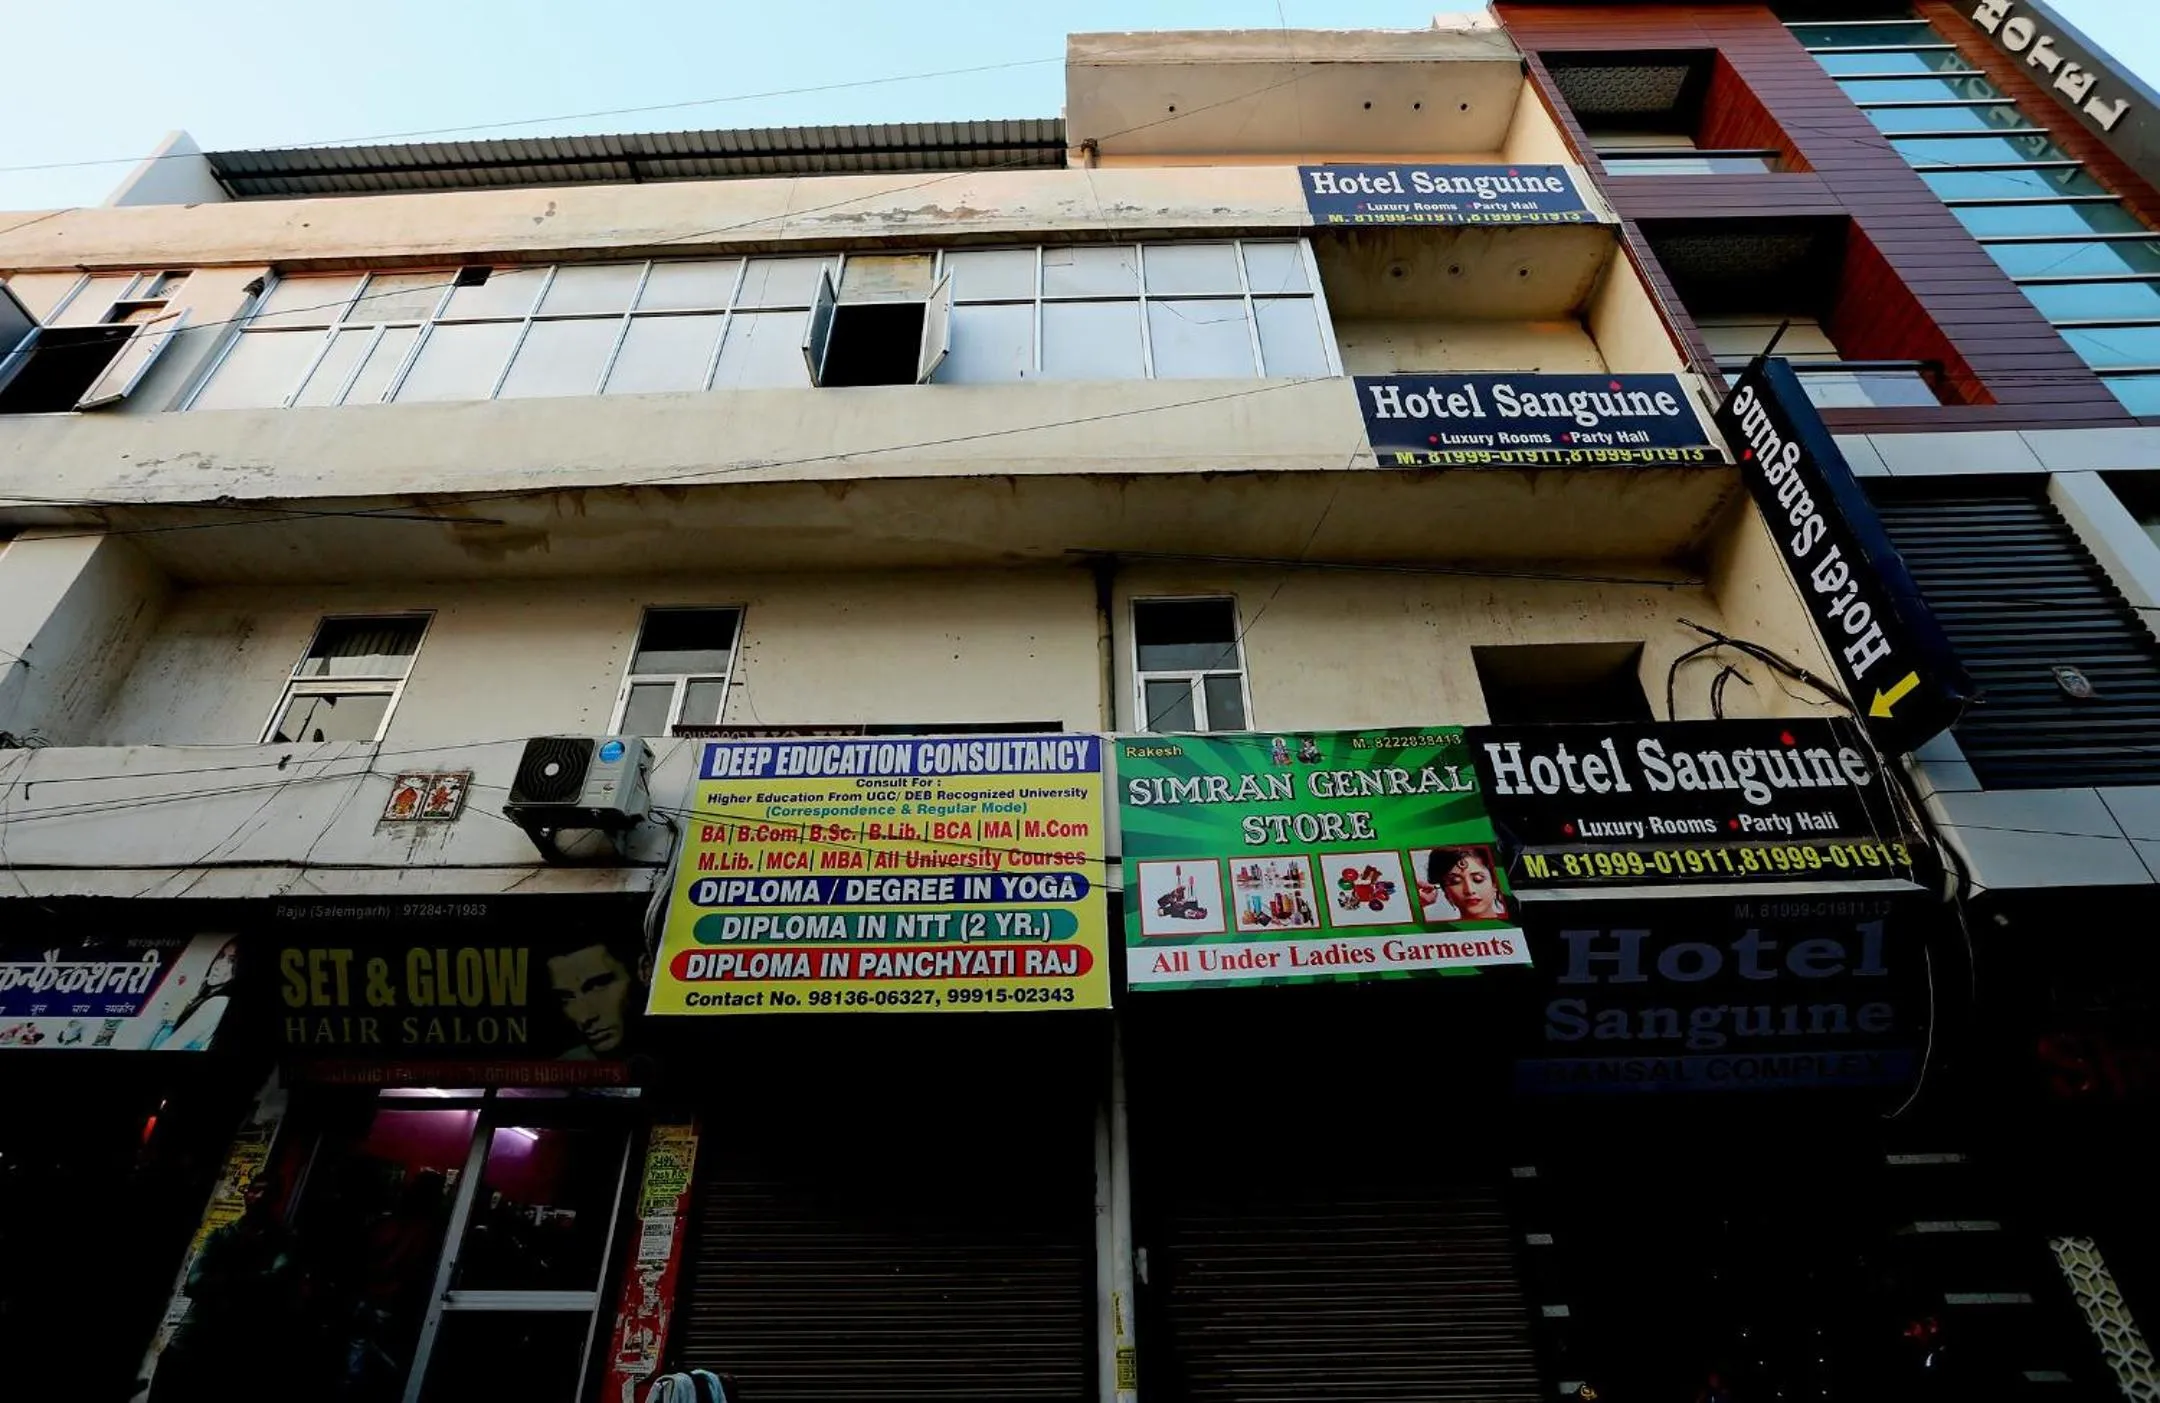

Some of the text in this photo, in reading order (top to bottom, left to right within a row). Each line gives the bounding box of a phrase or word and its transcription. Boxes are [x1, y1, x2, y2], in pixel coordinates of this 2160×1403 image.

[1310, 167, 1564, 199] Hotel Sanguine
[1366, 200, 1538, 213] Luxury Rooms Party Hall
[1369, 380, 1680, 427] Hotel Sanguine
[1441, 430, 1650, 447] Luxury Rooms Party Hall
[1733, 385, 1892, 681] Hotel Sanguine
[711, 740, 1089, 777] DEEP EDUCATION CONSULTANCY
[1126, 745, 1184, 758] Rakesh
[1353, 738, 1371, 749] M.
[856, 777, 908, 788] Consult
[911, 777, 932, 788] For
[1484, 732, 1873, 805] Hotel Sanguine
[707, 786, 1088, 806] Higher Education From UGC/ DEB Recognized University
[1129, 765, 1474, 807] SIMRAN GENRAL
[766, 800, 1028, 819] (Correspondence & Regular Mode)
[700, 820, 1089, 845] BA B.Com B.Sc. B.Lib. BCA MA M.Com
[1242, 810, 1377, 846] STORE
[1577, 811, 1840, 839] Luxury Rooms Party Hall
[697, 850, 1087, 872] M.Lib. MCA MBA All University Courses
[1523, 843, 1913, 879] M. 81999-01911,81999-01913
[700, 875, 1078, 905] DIPLOMA / DEGREE IN YOGA
[275, 904, 306, 920] Raju
[721, 911, 1051, 942] DIPLOMA IN NTT (2 YR.)
[685, 949, 1079, 980] DIPLOMA IN PANCHYATI RAJ
[1152, 935, 1514, 974] All Under Ladies Garments
[1556, 919, 1889, 985] Hotel
[280, 946, 531, 1008] SET & GLOW
[685, 988, 1075, 1008] Contact No. 98136-06327, 99915-02343
[284, 1015, 529, 1045] HAIR SALON
[1544, 998, 1896, 1051] Sanguine
